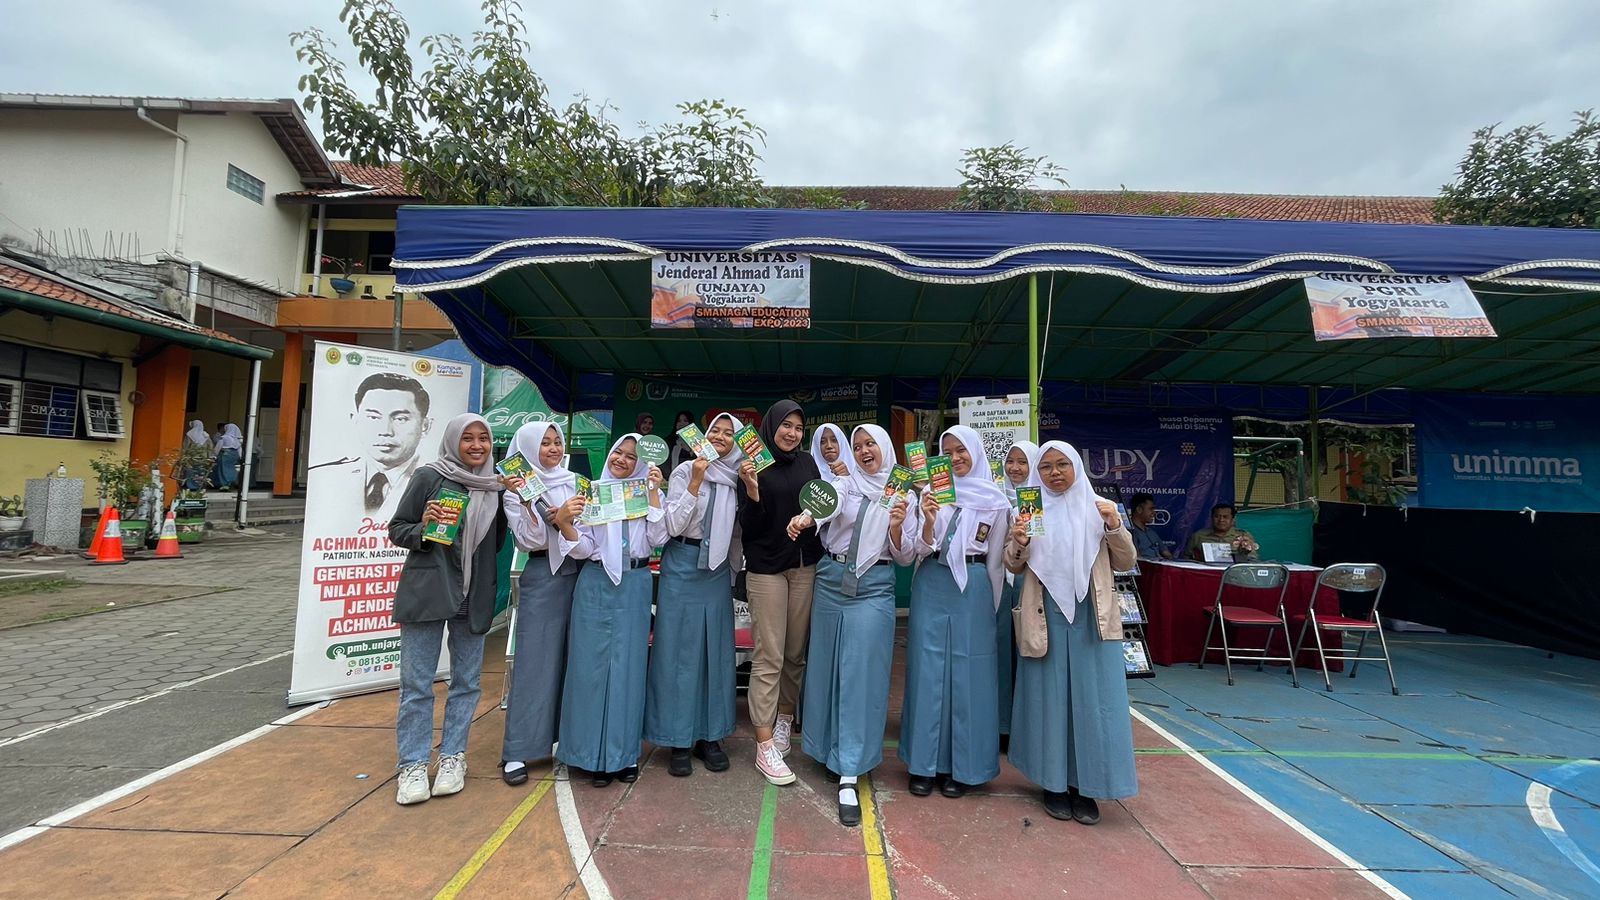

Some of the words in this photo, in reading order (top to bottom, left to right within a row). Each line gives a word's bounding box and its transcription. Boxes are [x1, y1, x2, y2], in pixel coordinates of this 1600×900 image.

[665, 252, 797, 263] UNIVERSITAS
[657, 265, 718, 280] Jenderal
[720, 266, 771, 280] Ahmad
[774, 265, 804, 279] Yani
[1317, 272, 1451, 284] UNIVERSITAS
[696, 283, 766, 294] (UNJAYA)
[1361, 286, 1422, 296] PGRI
[705, 294, 756, 305] Yogyakarta
[1343, 297, 1449, 310] Yogyakarta
[696, 308, 748, 317] SMANAGA
[751, 308, 809, 317] EDUCATION
[754, 318, 781, 327] EXPO
[783, 318, 809, 327] 2023
[1357, 317, 1421, 327] SMANAGA
[1434, 328, 1464, 336] EXPO
[969, 421, 994, 429] UNJAYA
[995, 420, 1025, 428] PRIORITAS
[639, 440, 665, 449] UNJAYA
[1081, 449, 1161, 480] UPY
[1451, 449, 1582, 476] unimma
[810, 482, 835, 506] UNJAYA
[1135, 487, 1186, 495] YOGYAKARTA
[440, 498, 464, 509] PMDK
[313, 536, 378, 552] ACHMAD
[323, 551, 368, 560] PATRIOTIK,
[316, 565, 387, 582] GENERASI
[323, 583, 361, 598] NILAI
[358, 653, 400, 667] 0813-500
